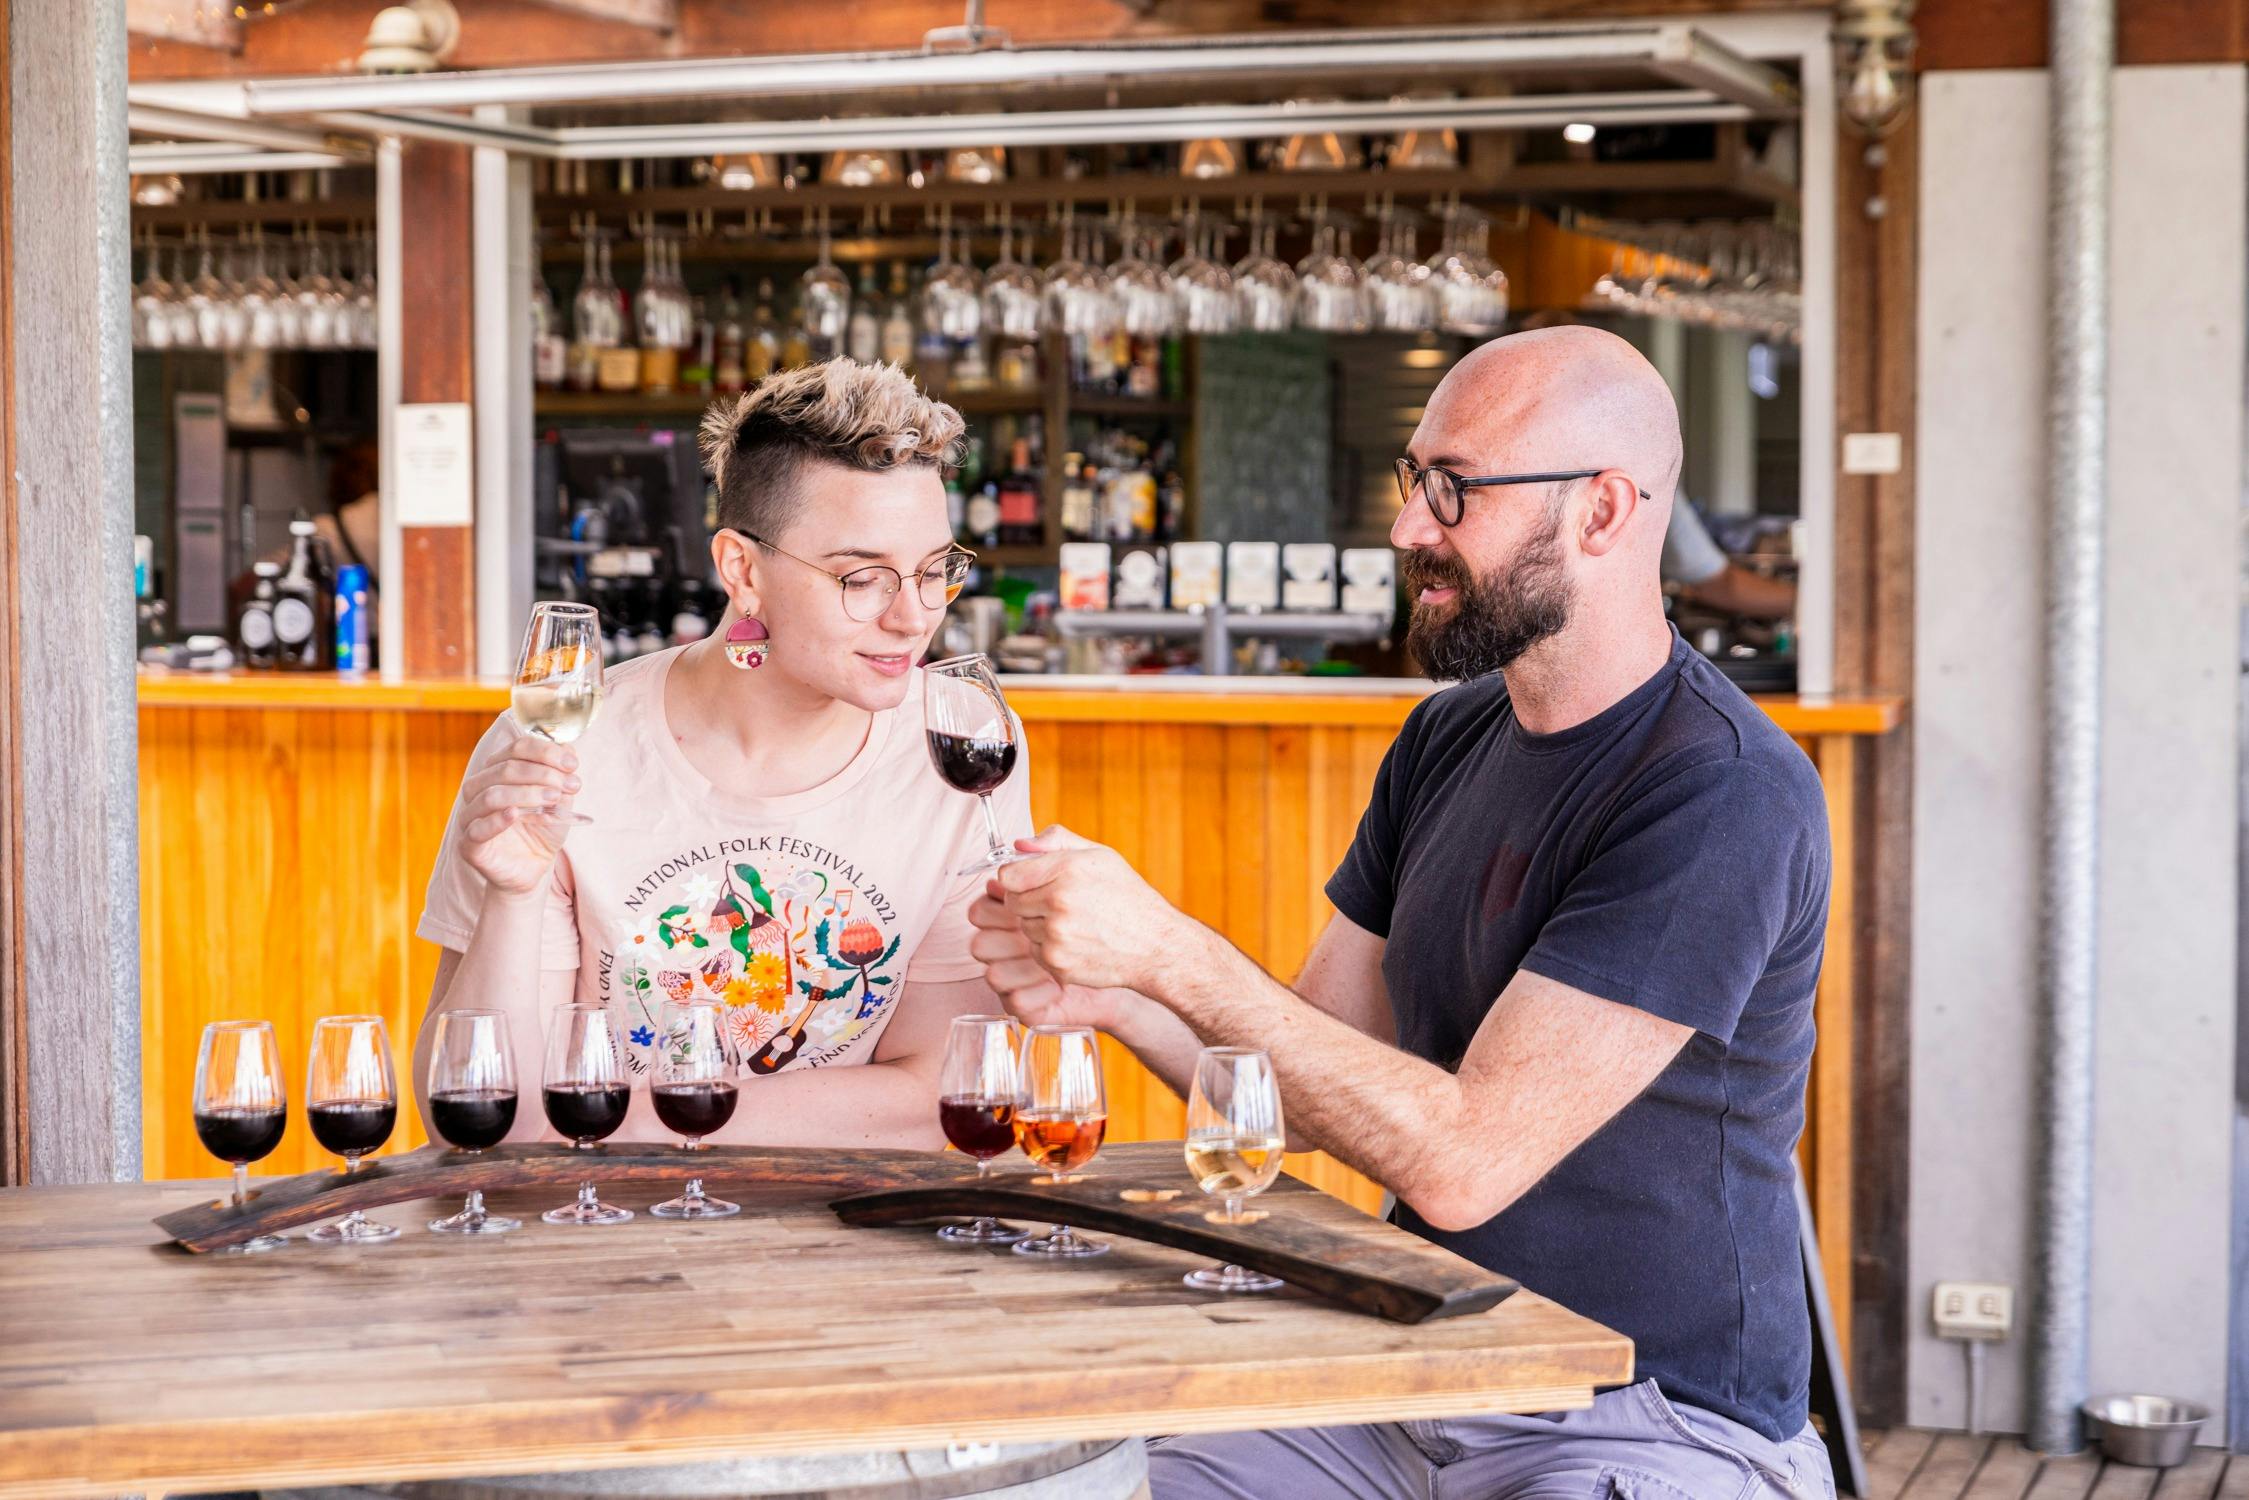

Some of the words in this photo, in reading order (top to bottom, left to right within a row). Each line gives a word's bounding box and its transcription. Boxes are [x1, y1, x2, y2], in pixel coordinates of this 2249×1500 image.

[624, 846, 716, 912] NATIONAL
[719, 836, 772, 855] FOLK
[778, 836, 864, 889] FESTIVAL
[863, 884, 897, 925] 2022
[599, 949, 614, 991] FIND
[810, 1043, 850, 1068] FIND
